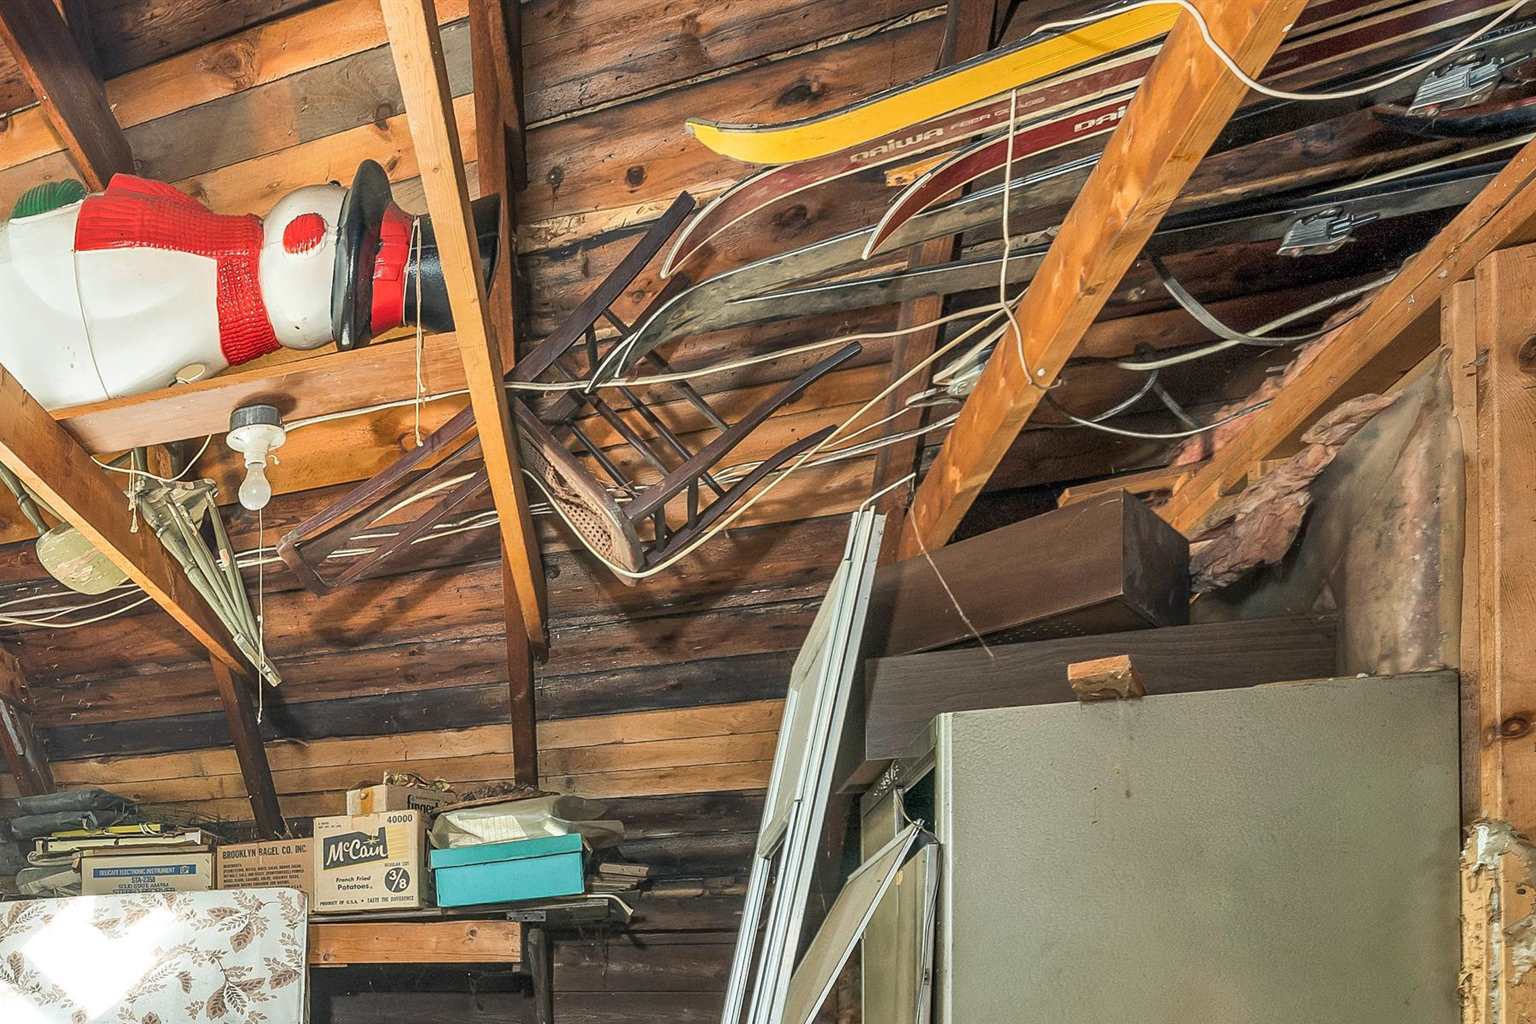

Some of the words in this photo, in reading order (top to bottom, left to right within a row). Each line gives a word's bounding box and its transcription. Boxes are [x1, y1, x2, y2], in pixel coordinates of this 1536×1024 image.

[1074, 105, 1127, 133] DAI
[387, 814, 413, 824] 40000
[223, 849, 257, 860] BROOKLYN
[258, 847, 280, 857] BAGEL
[326, 839, 389, 866] McCain
